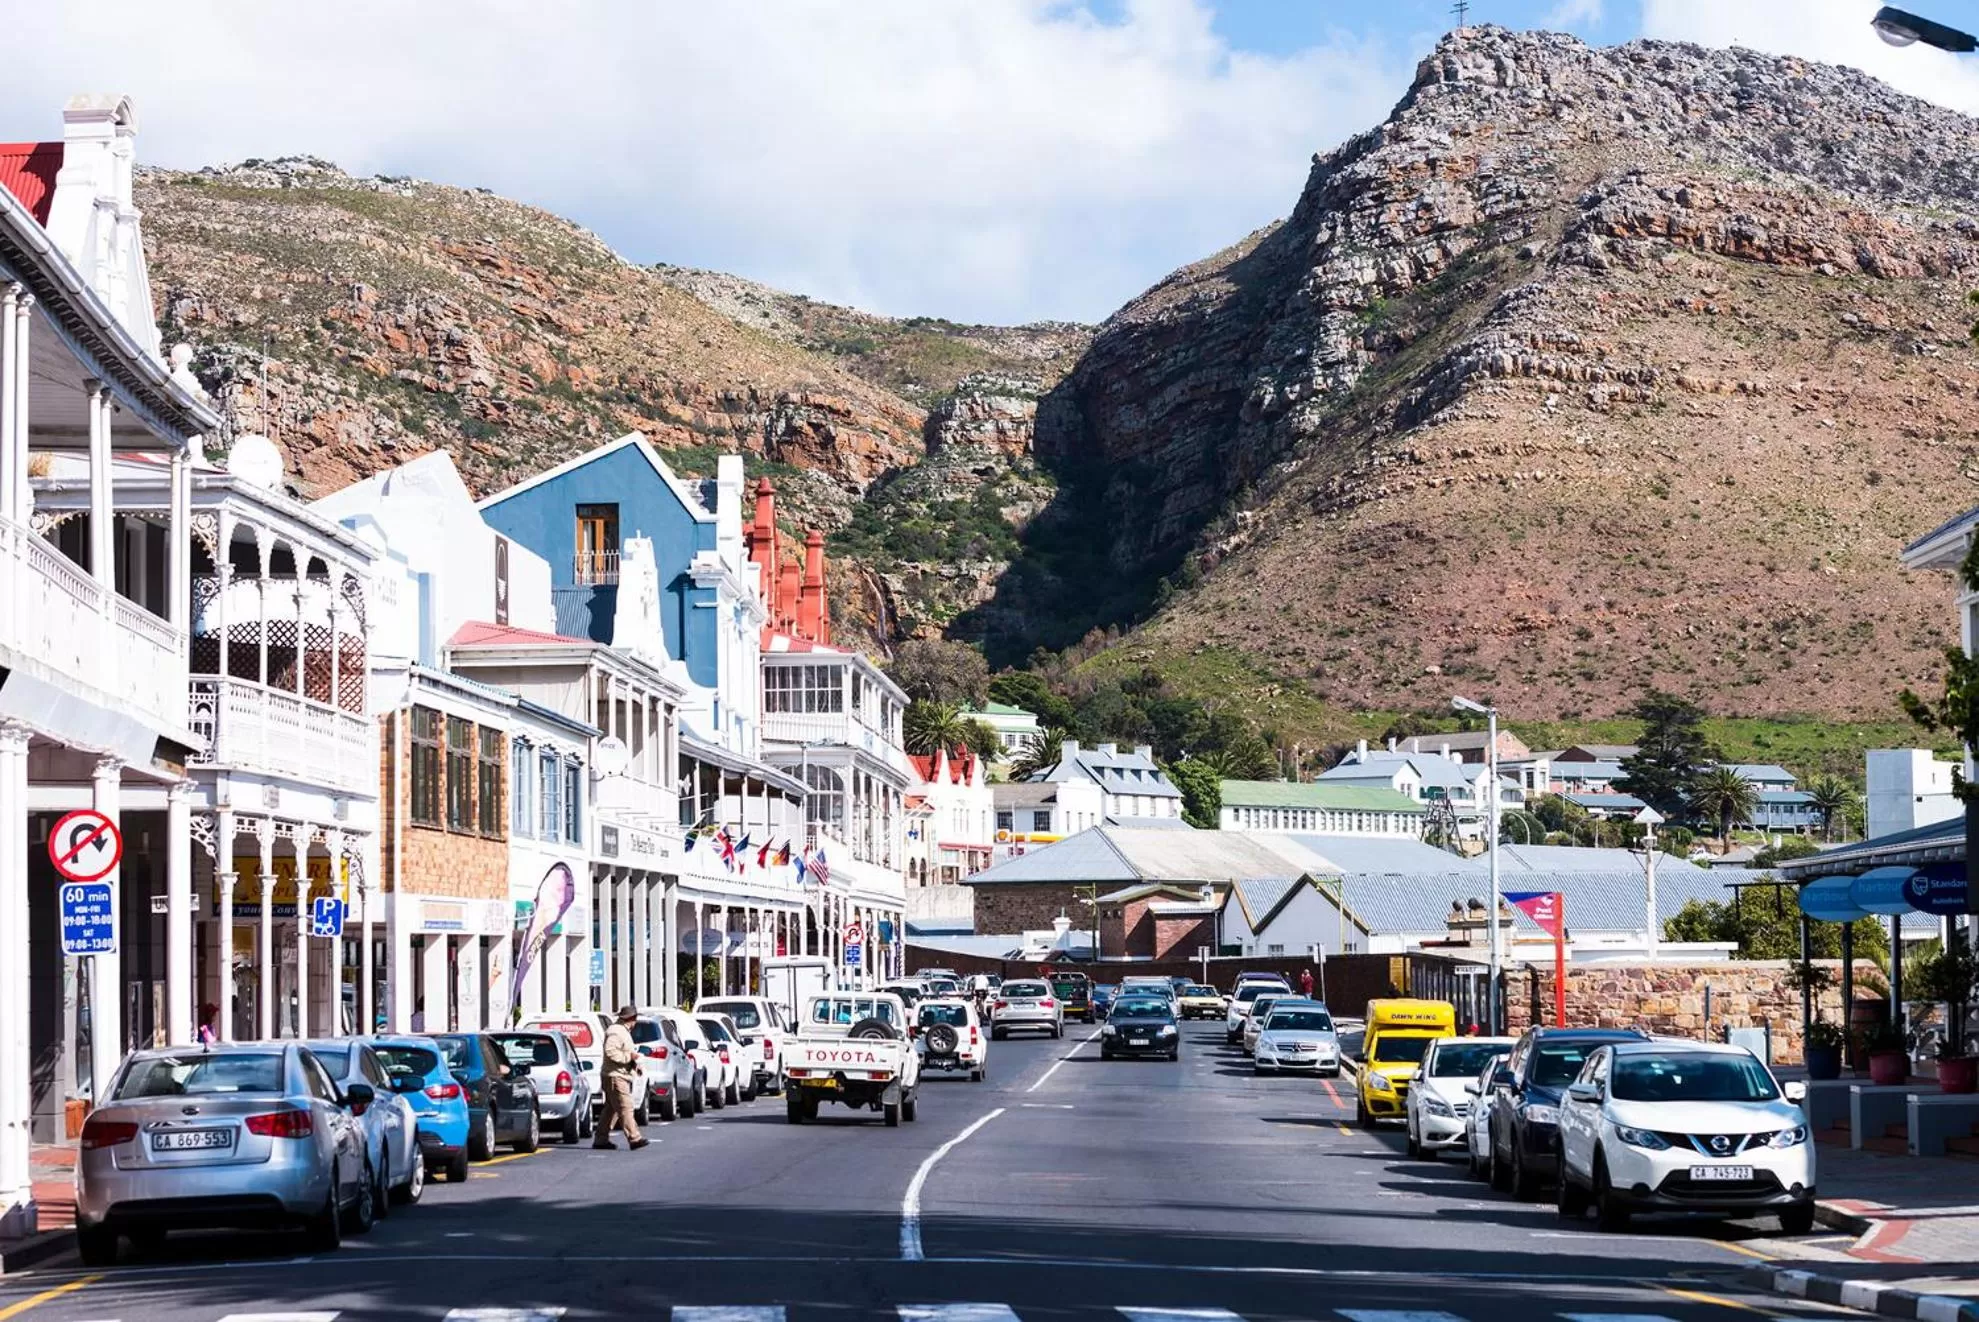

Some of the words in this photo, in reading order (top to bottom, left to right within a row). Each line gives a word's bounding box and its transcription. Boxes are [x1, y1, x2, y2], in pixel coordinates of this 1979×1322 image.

[66, 887, 84, 903] 60
[88, 891, 109, 901] min
[322, 902, 336, 915] P
[527, 932, 547, 964] OPEN
[806, 1050, 875, 1063] TOYOTA
[155, 1136, 171, 1148] CA
[1695, 1167, 1706, 1178] CA
